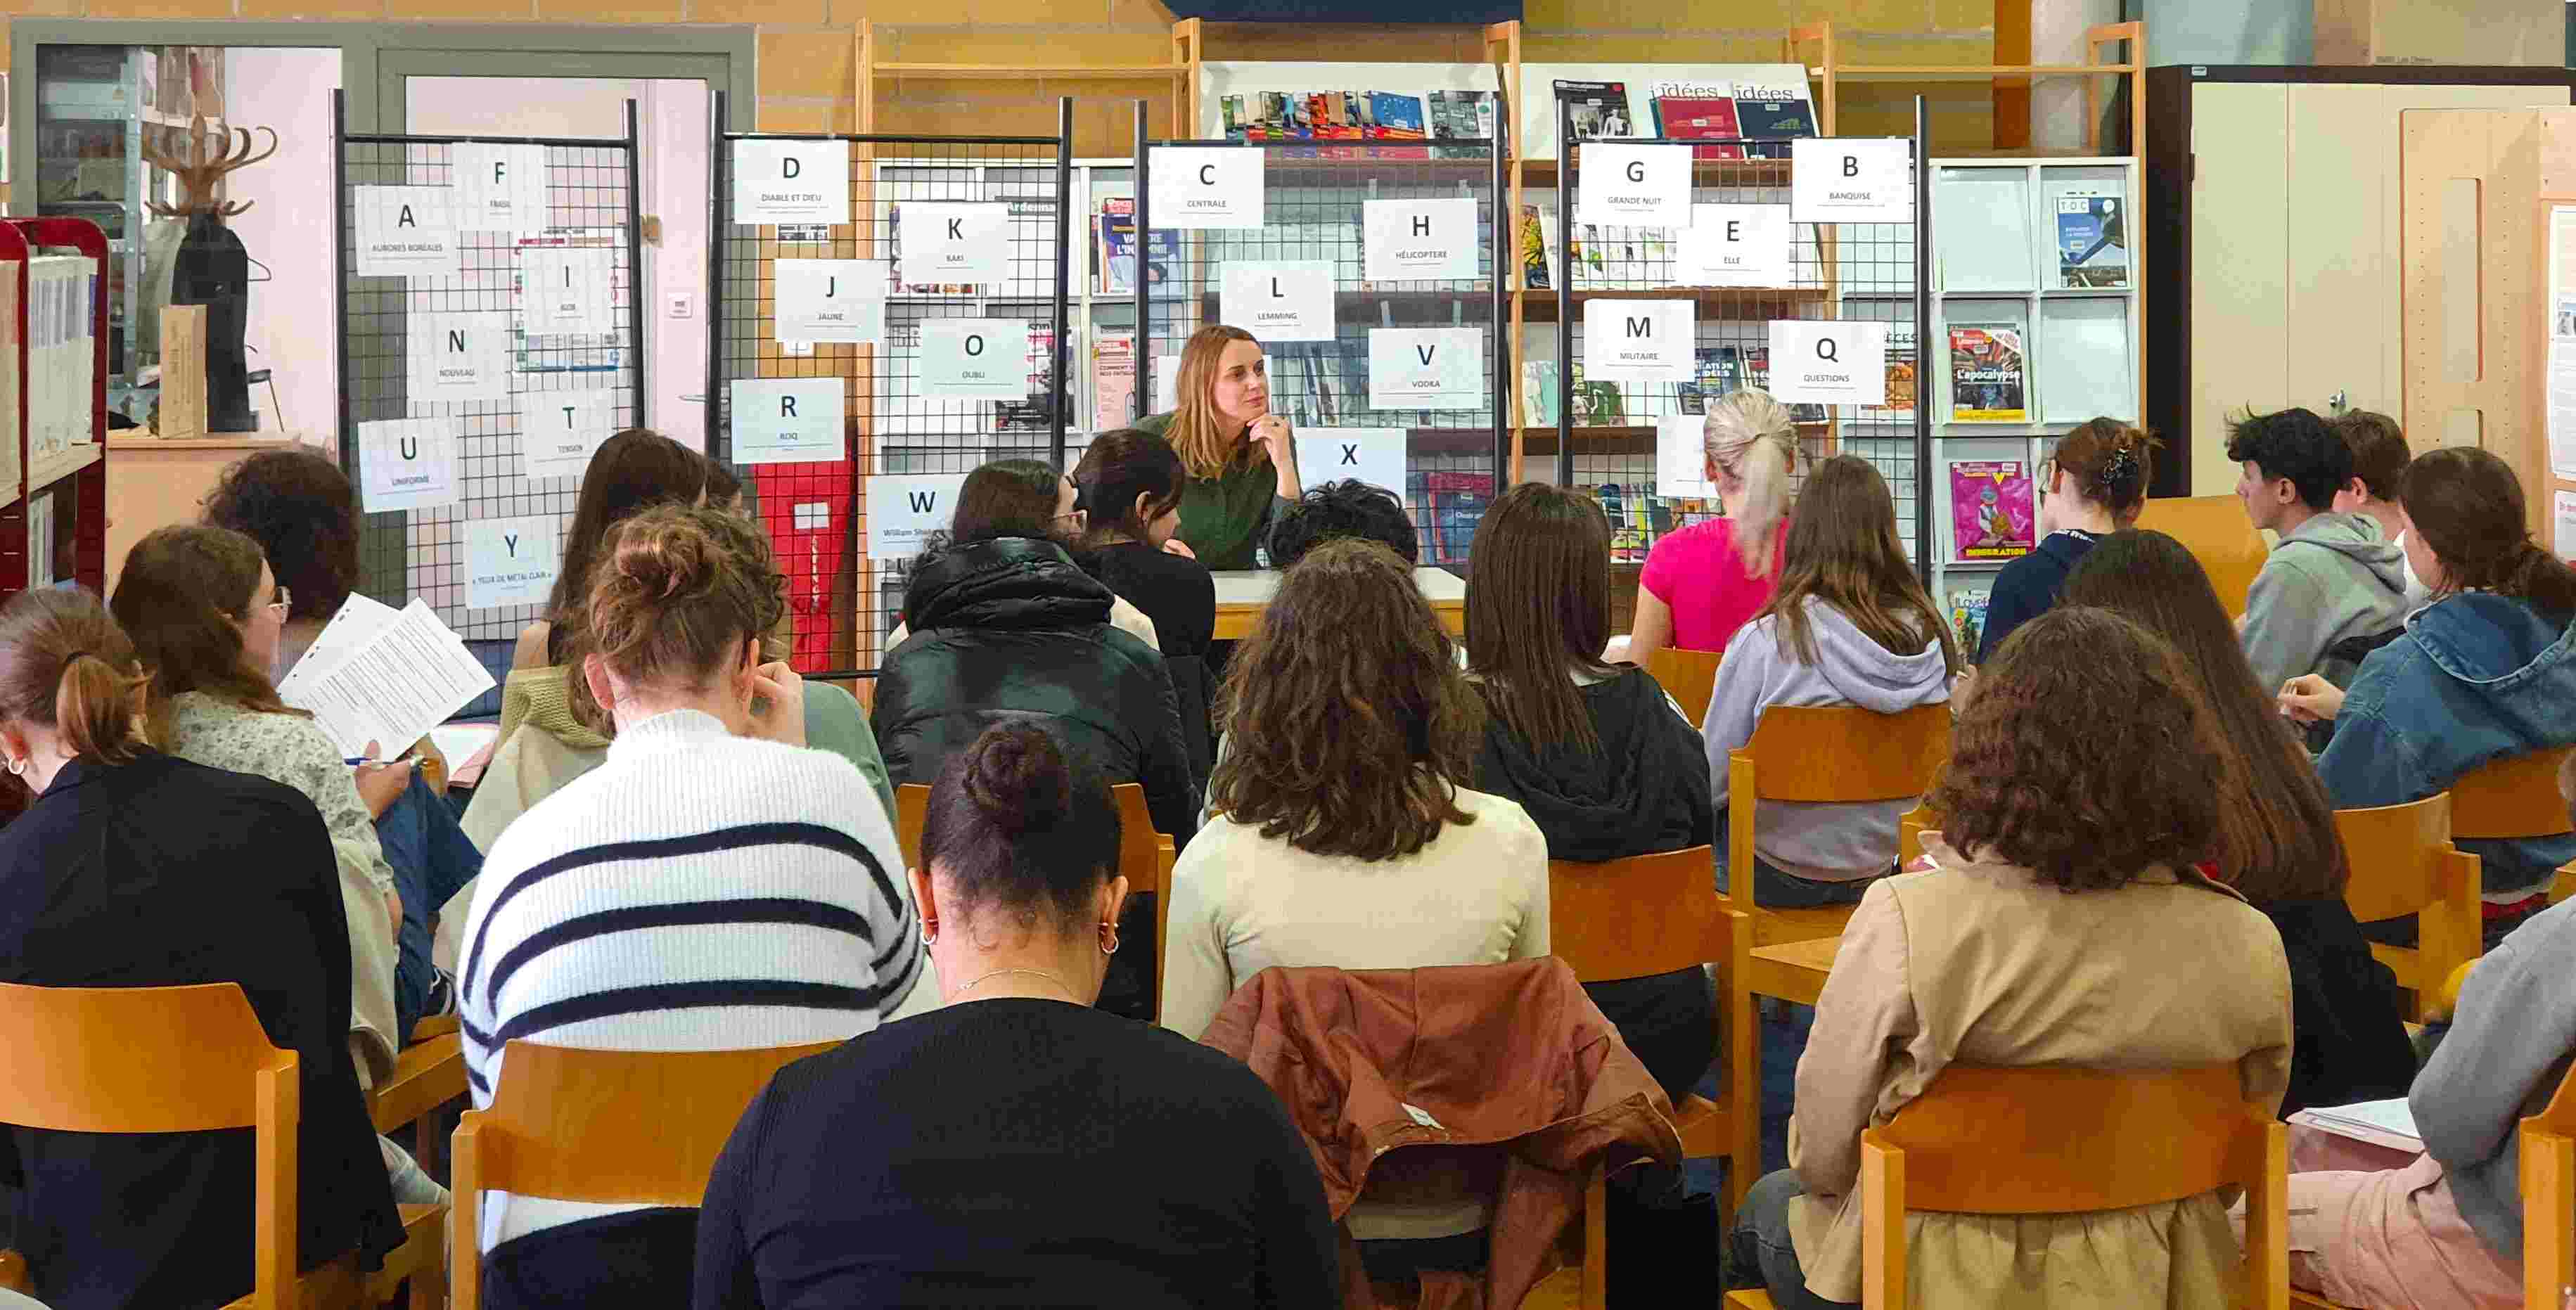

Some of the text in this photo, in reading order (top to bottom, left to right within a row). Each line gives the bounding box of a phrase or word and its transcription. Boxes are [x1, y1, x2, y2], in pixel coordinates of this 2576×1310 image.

[1661, 82, 1718, 98] idées
[1736, 84, 1793, 101] idées
[494, 162, 505, 184] F
[783, 157, 800, 179] D
[1199, 164, 1215, 186] C
[1626, 160, 1644, 183] G
[1843, 155, 1859, 177] B
[761, 193, 822, 203] DIABLE ET DIEU
[1186, 200, 1227, 208] CENTRALE
[1608, 196, 1662, 205] GRANDE NUIT
[1828, 192, 1871, 200] BANQUISE
[398, 204, 416, 228] A
[1412, 215, 1430, 237] H
[948, 218, 963, 240] K
[1726, 220, 1740, 242] E
[372, 243, 406, 252] AURORES
[1724, 256, 1741, 265] ELLE
[826, 276, 835, 298] J
[1271, 277, 1284, 298] L
[818, 313, 844, 321] JAUNE
[1257, 312, 1297, 321] LEMMING
[1627, 316, 1651, 338] M
[449, 330, 465, 353] N
[965, 334, 984, 357] O
[1816, 338, 1839, 363] Q
[1416, 345, 1435, 366] V
[1620, 352, 1659, 361] MILITAIRE
[439, 368, 475, 378] NOUVEAU
[961, 371, 985, 379] OUBLI
[1803, 374, 1850, 383] QUESTIONS
[1957, 369, 2020, 381] L'apocalypse
[781, 395, 797, 418] R
[562, 406, 575, 430] T
[400, 437, 417, 461] U
[1340, 444, 1358, 465] X
[392, 476, 430, 487] UNIFORME
[909, 491, 936, 513] W
[504, 534, 518, 558] Y
